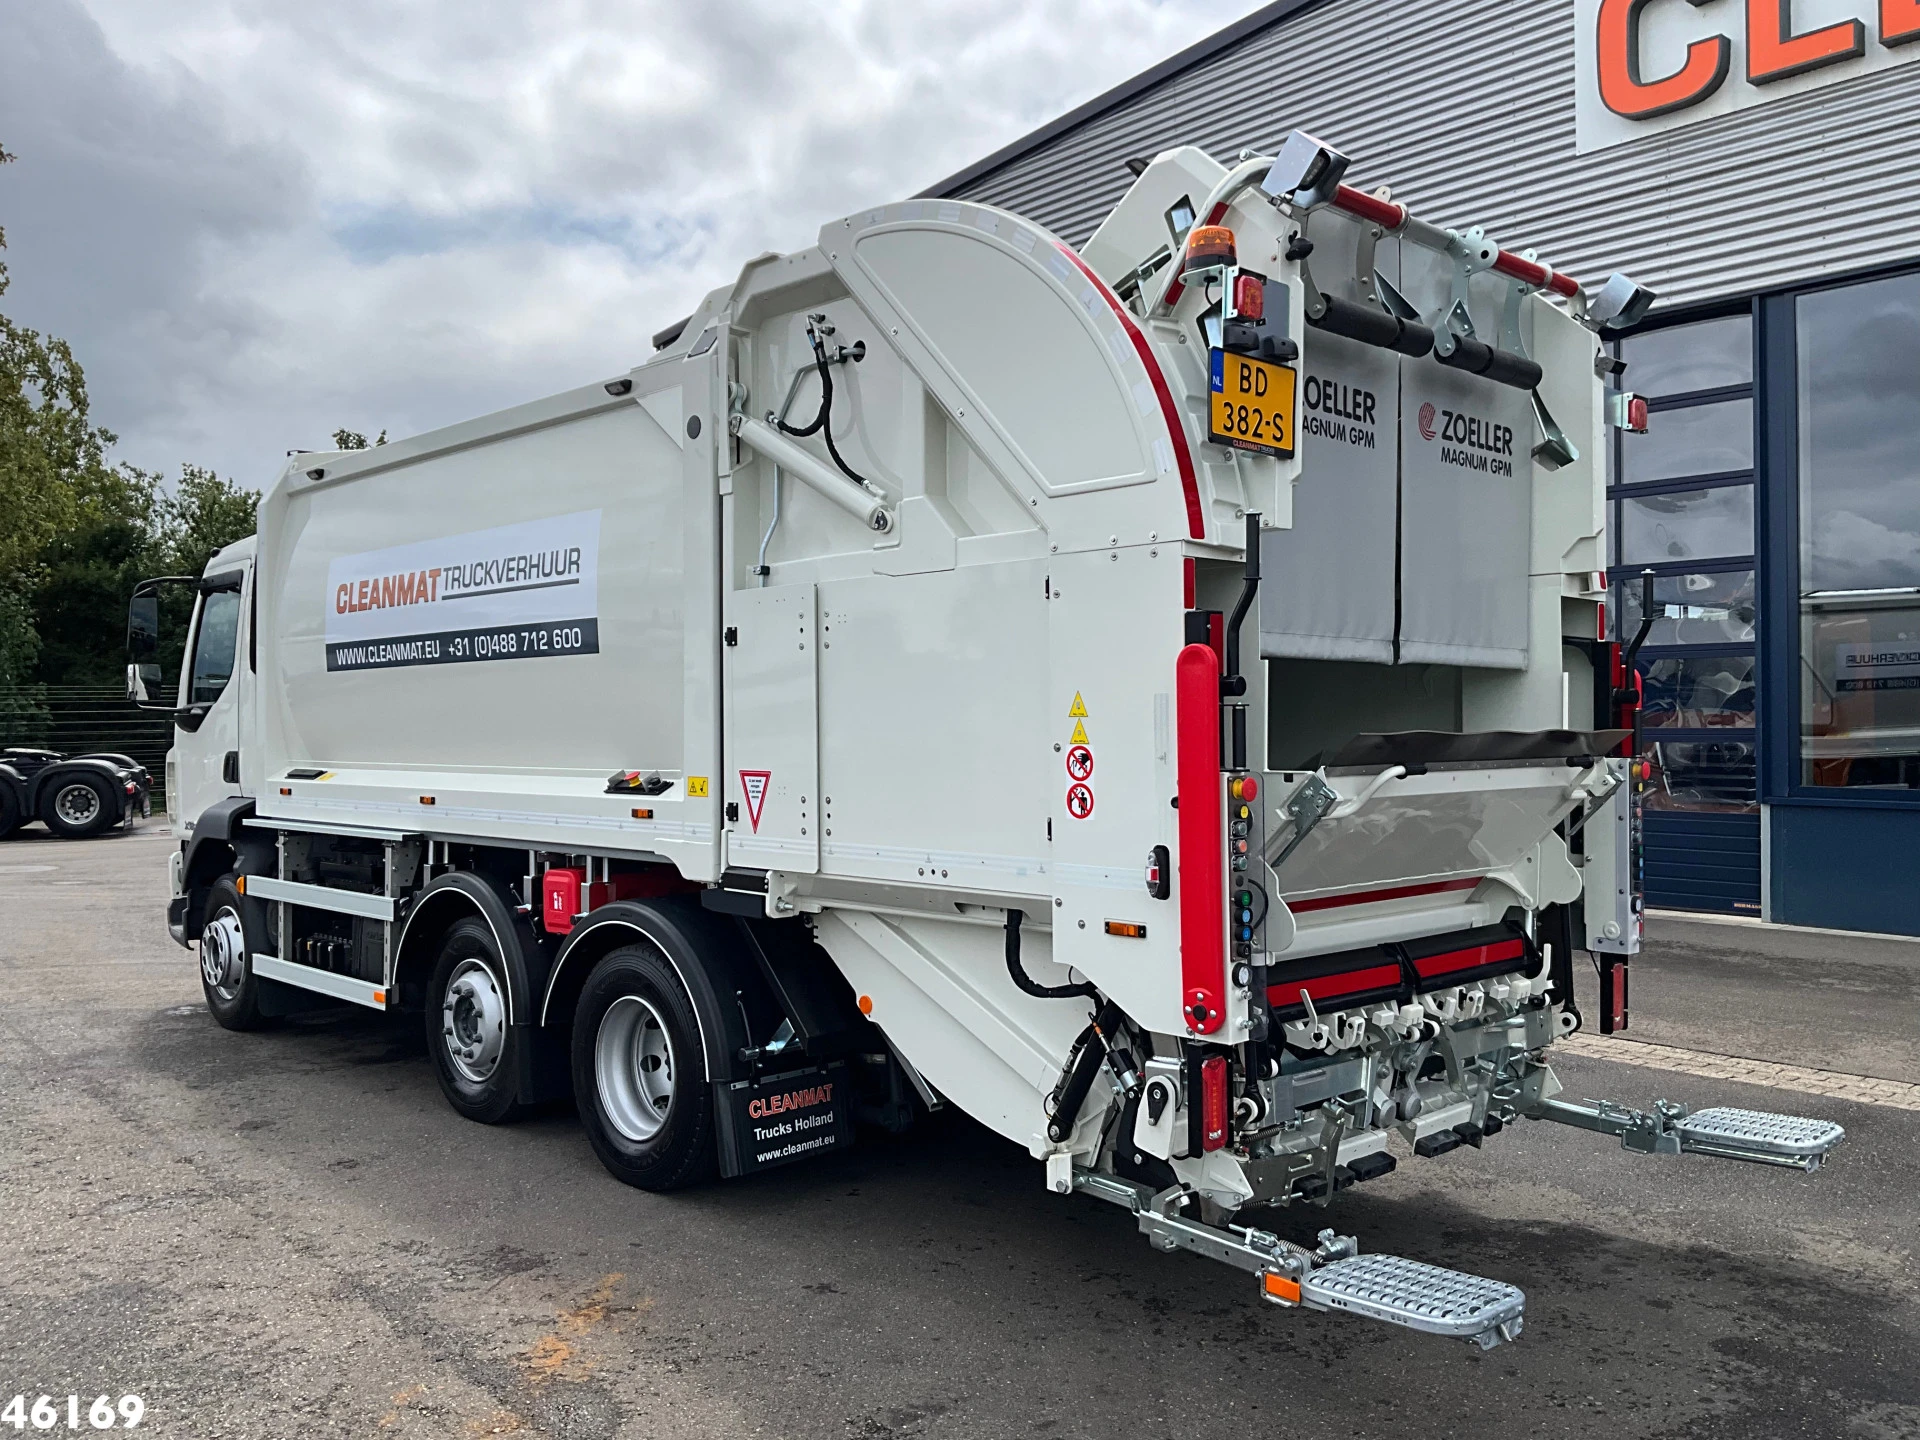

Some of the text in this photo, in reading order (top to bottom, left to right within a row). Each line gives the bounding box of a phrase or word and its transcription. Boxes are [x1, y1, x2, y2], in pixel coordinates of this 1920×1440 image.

[1596, 0, 1920, 120] CL
[1212, 375, 1222, 386] NL
[1239, 362, 1268, 397] BD
[1302, 375, 1376, 426] OELLER
[1223, 401, 1284, 443] 382-S
[1302, 414, 1375, 449] AGNUM GPM
[1441, 409, 1513, 457] ZOELLER
[1441, 446, 1512, 478] MAGNUM GPM
[336, 547, 581, 614] CLEANMAT TRUCKVERHUUR
[336, 627, 582, 666] WWW.CLEANMAT.EU +31 (0)488 712 600
[749, 1084, 833, 1119] CLEANMAT
[754, 1110, 834, 1141] Trucks Holland
[756, 1135, 835, 1162] www.cleanmat.eu
